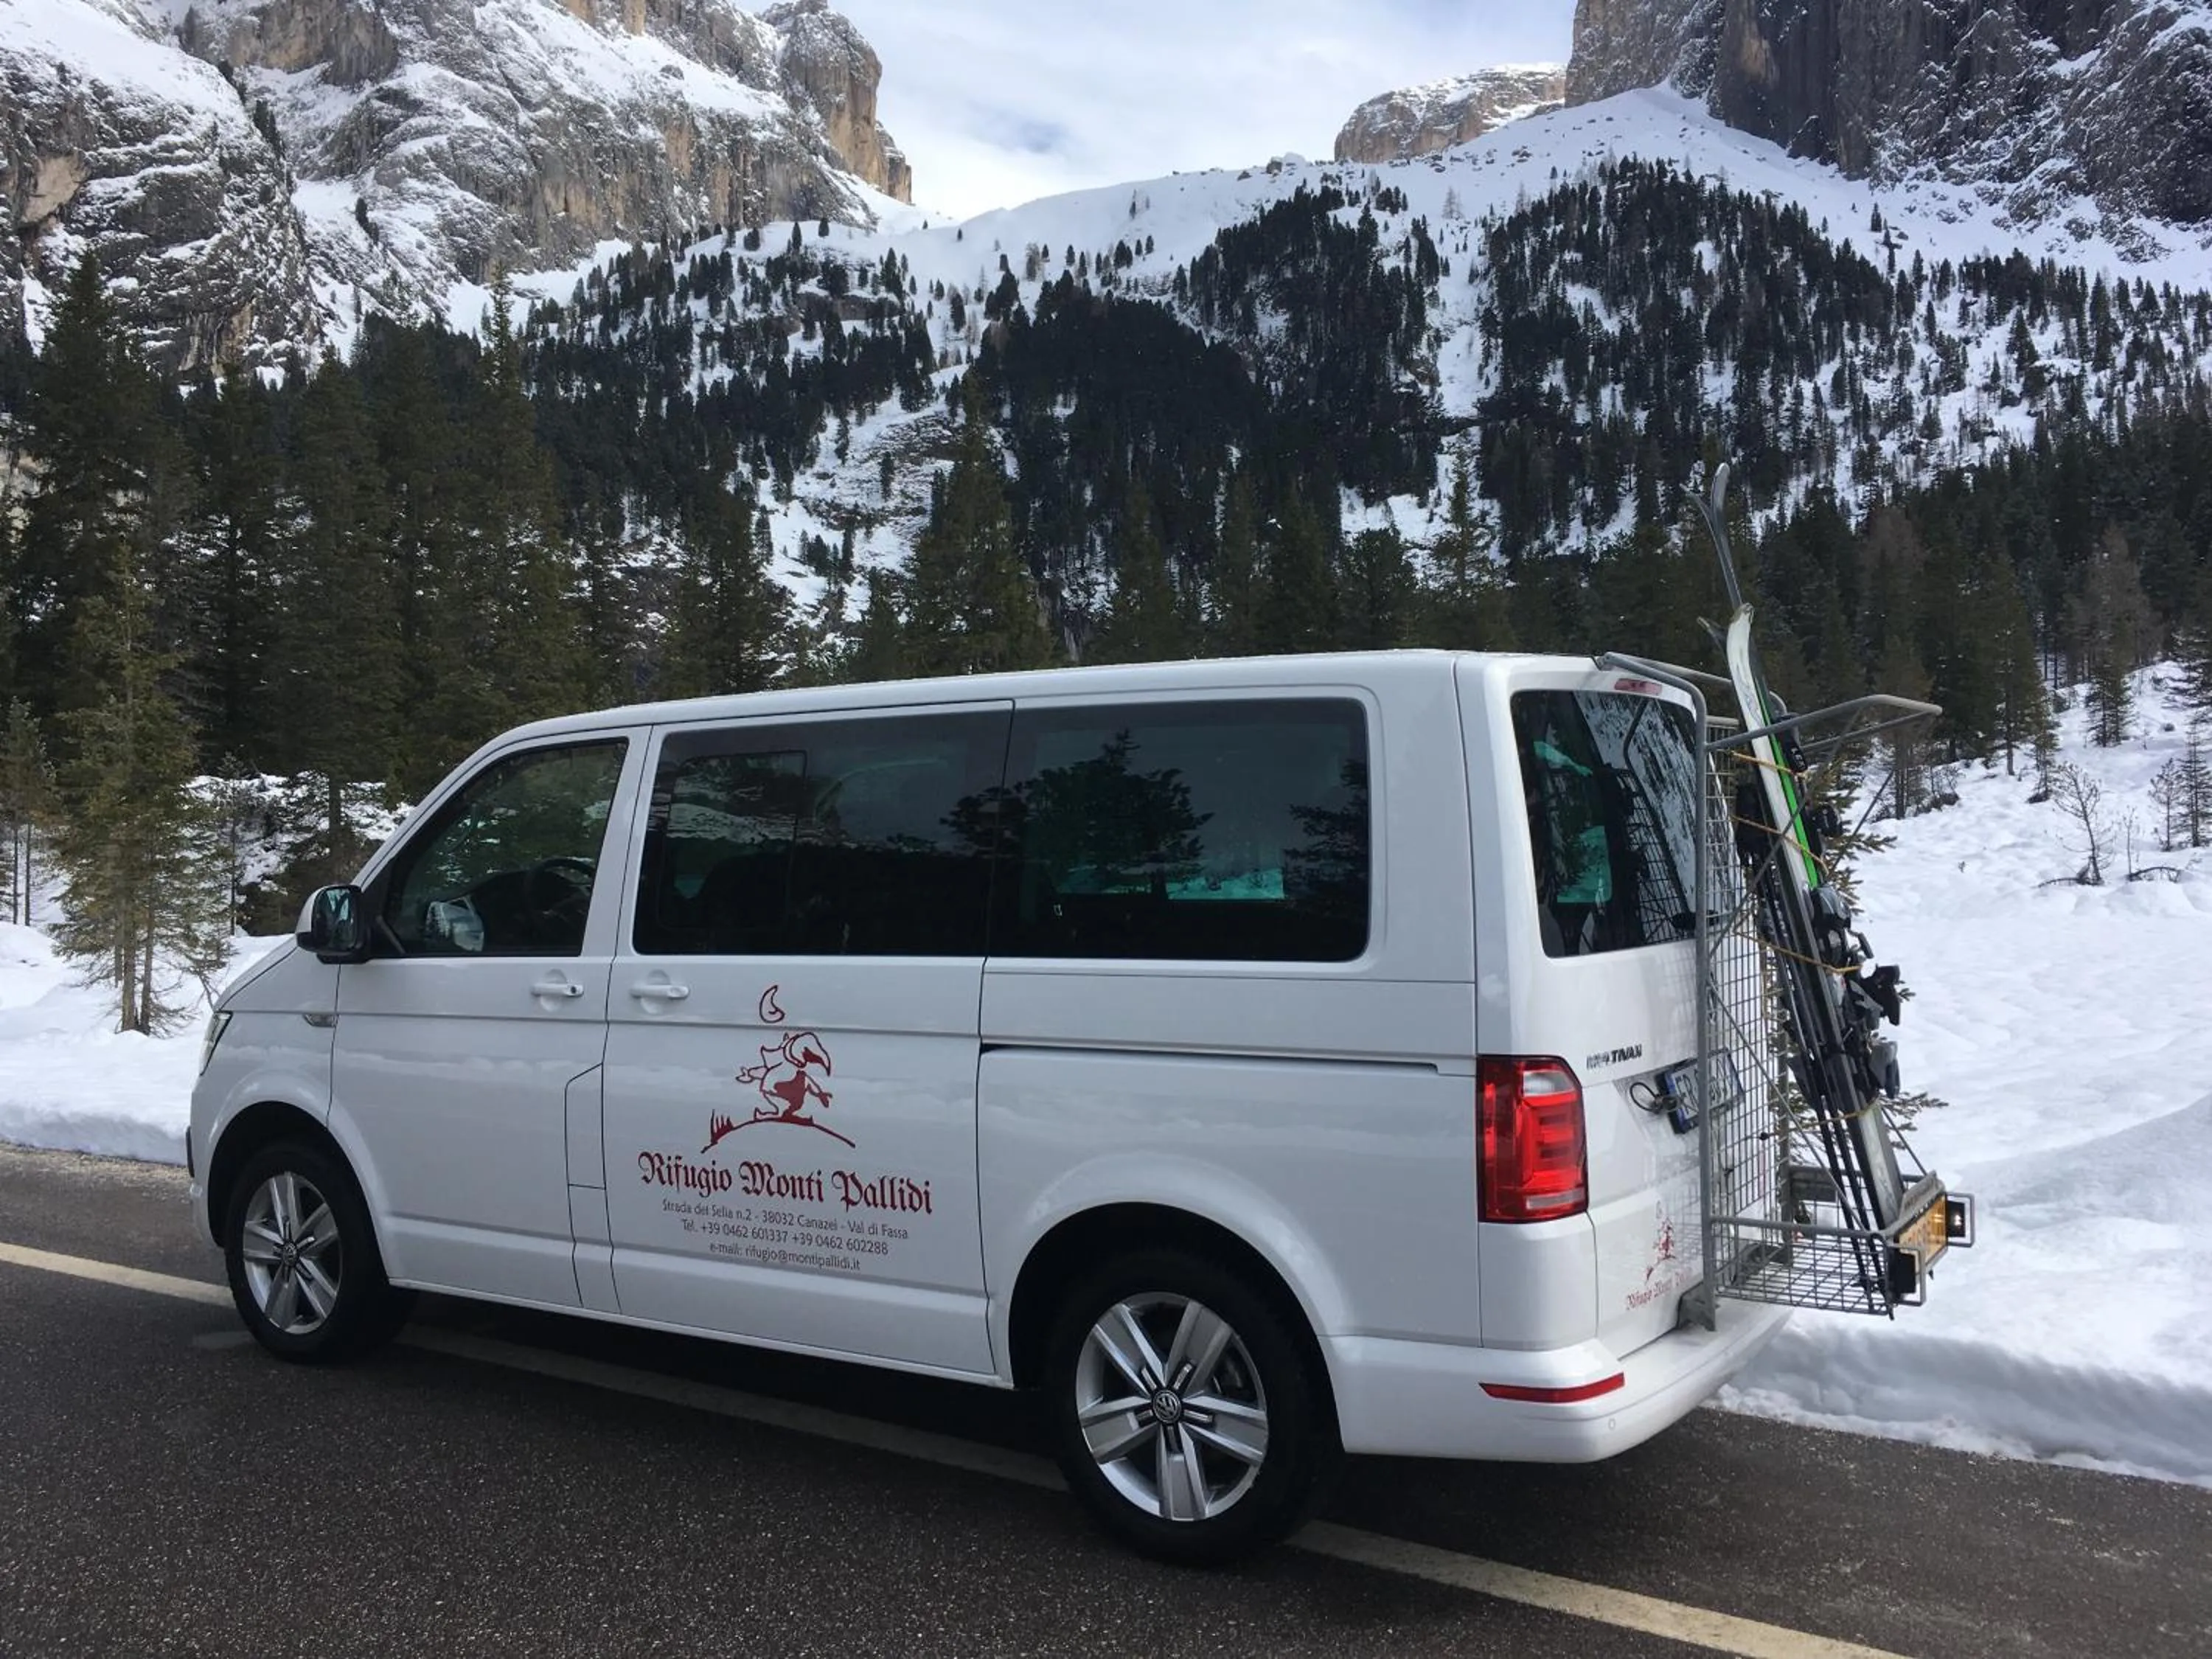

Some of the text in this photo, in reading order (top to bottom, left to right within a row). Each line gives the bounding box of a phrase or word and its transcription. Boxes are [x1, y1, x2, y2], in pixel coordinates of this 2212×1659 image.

[638, 1152, 933, 1214] Rifugio Monti Pallidi
[663, 1198, 692, 1214] Strada
[762, 1210, 794, 1225] 38032
[797, 1214, 838, 1231] Canazei
[848, 1220, 864, 1234] Val
[868, 1223, 878, 1236] di
[881, 1224, 908, 1239] Fassa
[702, 1222, 720, 1234] +39
[723, 1223, 748, 1238] 0462
[751, 1226, 788, 1243] 601337
[792, 1232, 813, 1246] +39
[815, 1234, 843, 1250] 0462
[846, 1238, 888, 1255] 602288
